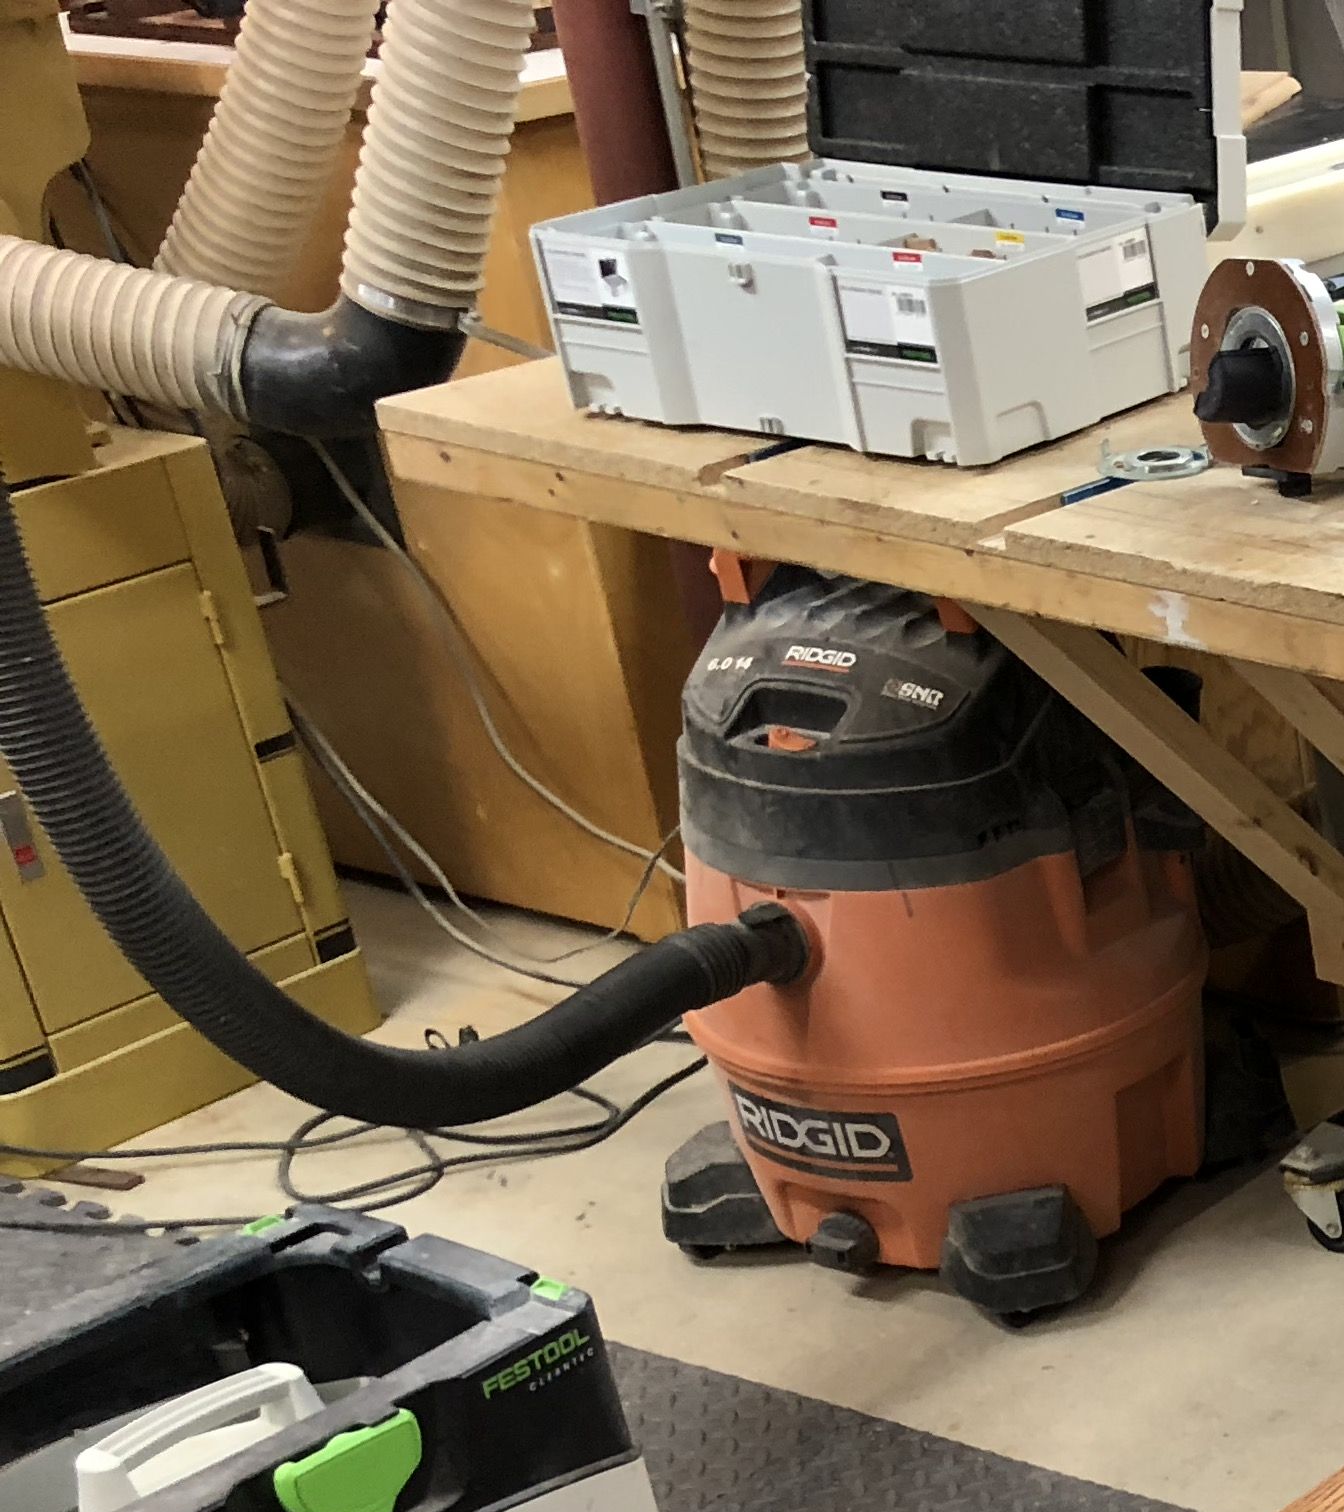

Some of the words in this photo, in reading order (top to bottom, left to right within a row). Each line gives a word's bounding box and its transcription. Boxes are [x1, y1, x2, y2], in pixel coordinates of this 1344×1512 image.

[785, 645, 857, 668] RIDGID
[735, 1092, 891, 1159] RIDGID
[482, 1328, 591, 1400] FESTOOL
